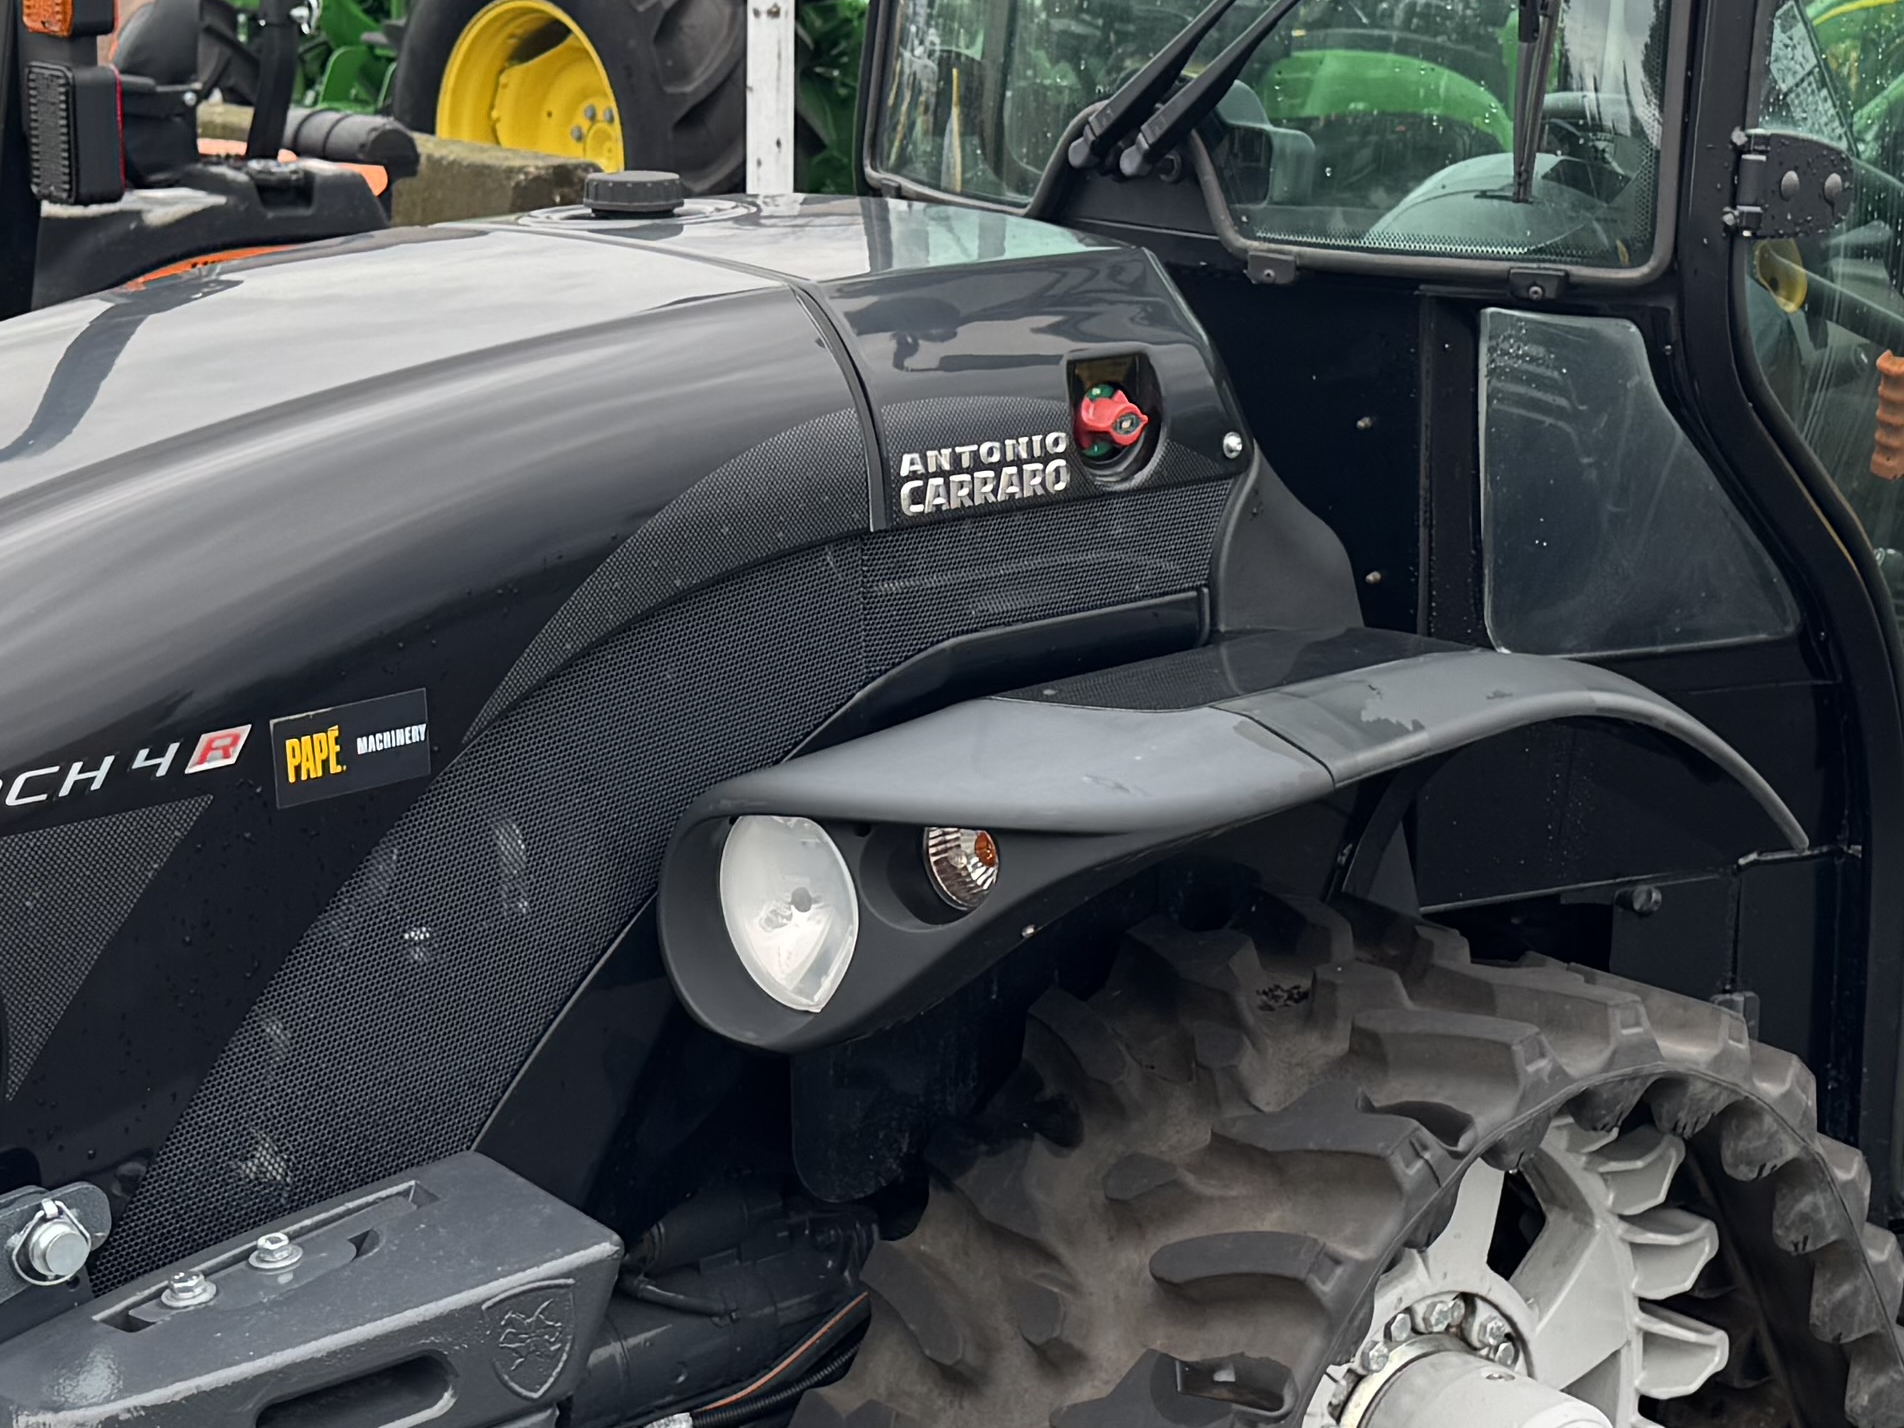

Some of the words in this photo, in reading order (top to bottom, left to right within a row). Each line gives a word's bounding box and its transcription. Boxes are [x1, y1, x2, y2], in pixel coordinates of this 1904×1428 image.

[899, 431, 1070, 477] ANTONIO
[900, 458, 1070, 517] CARRARO
[356, 723, 427, 755] MACHINERY
